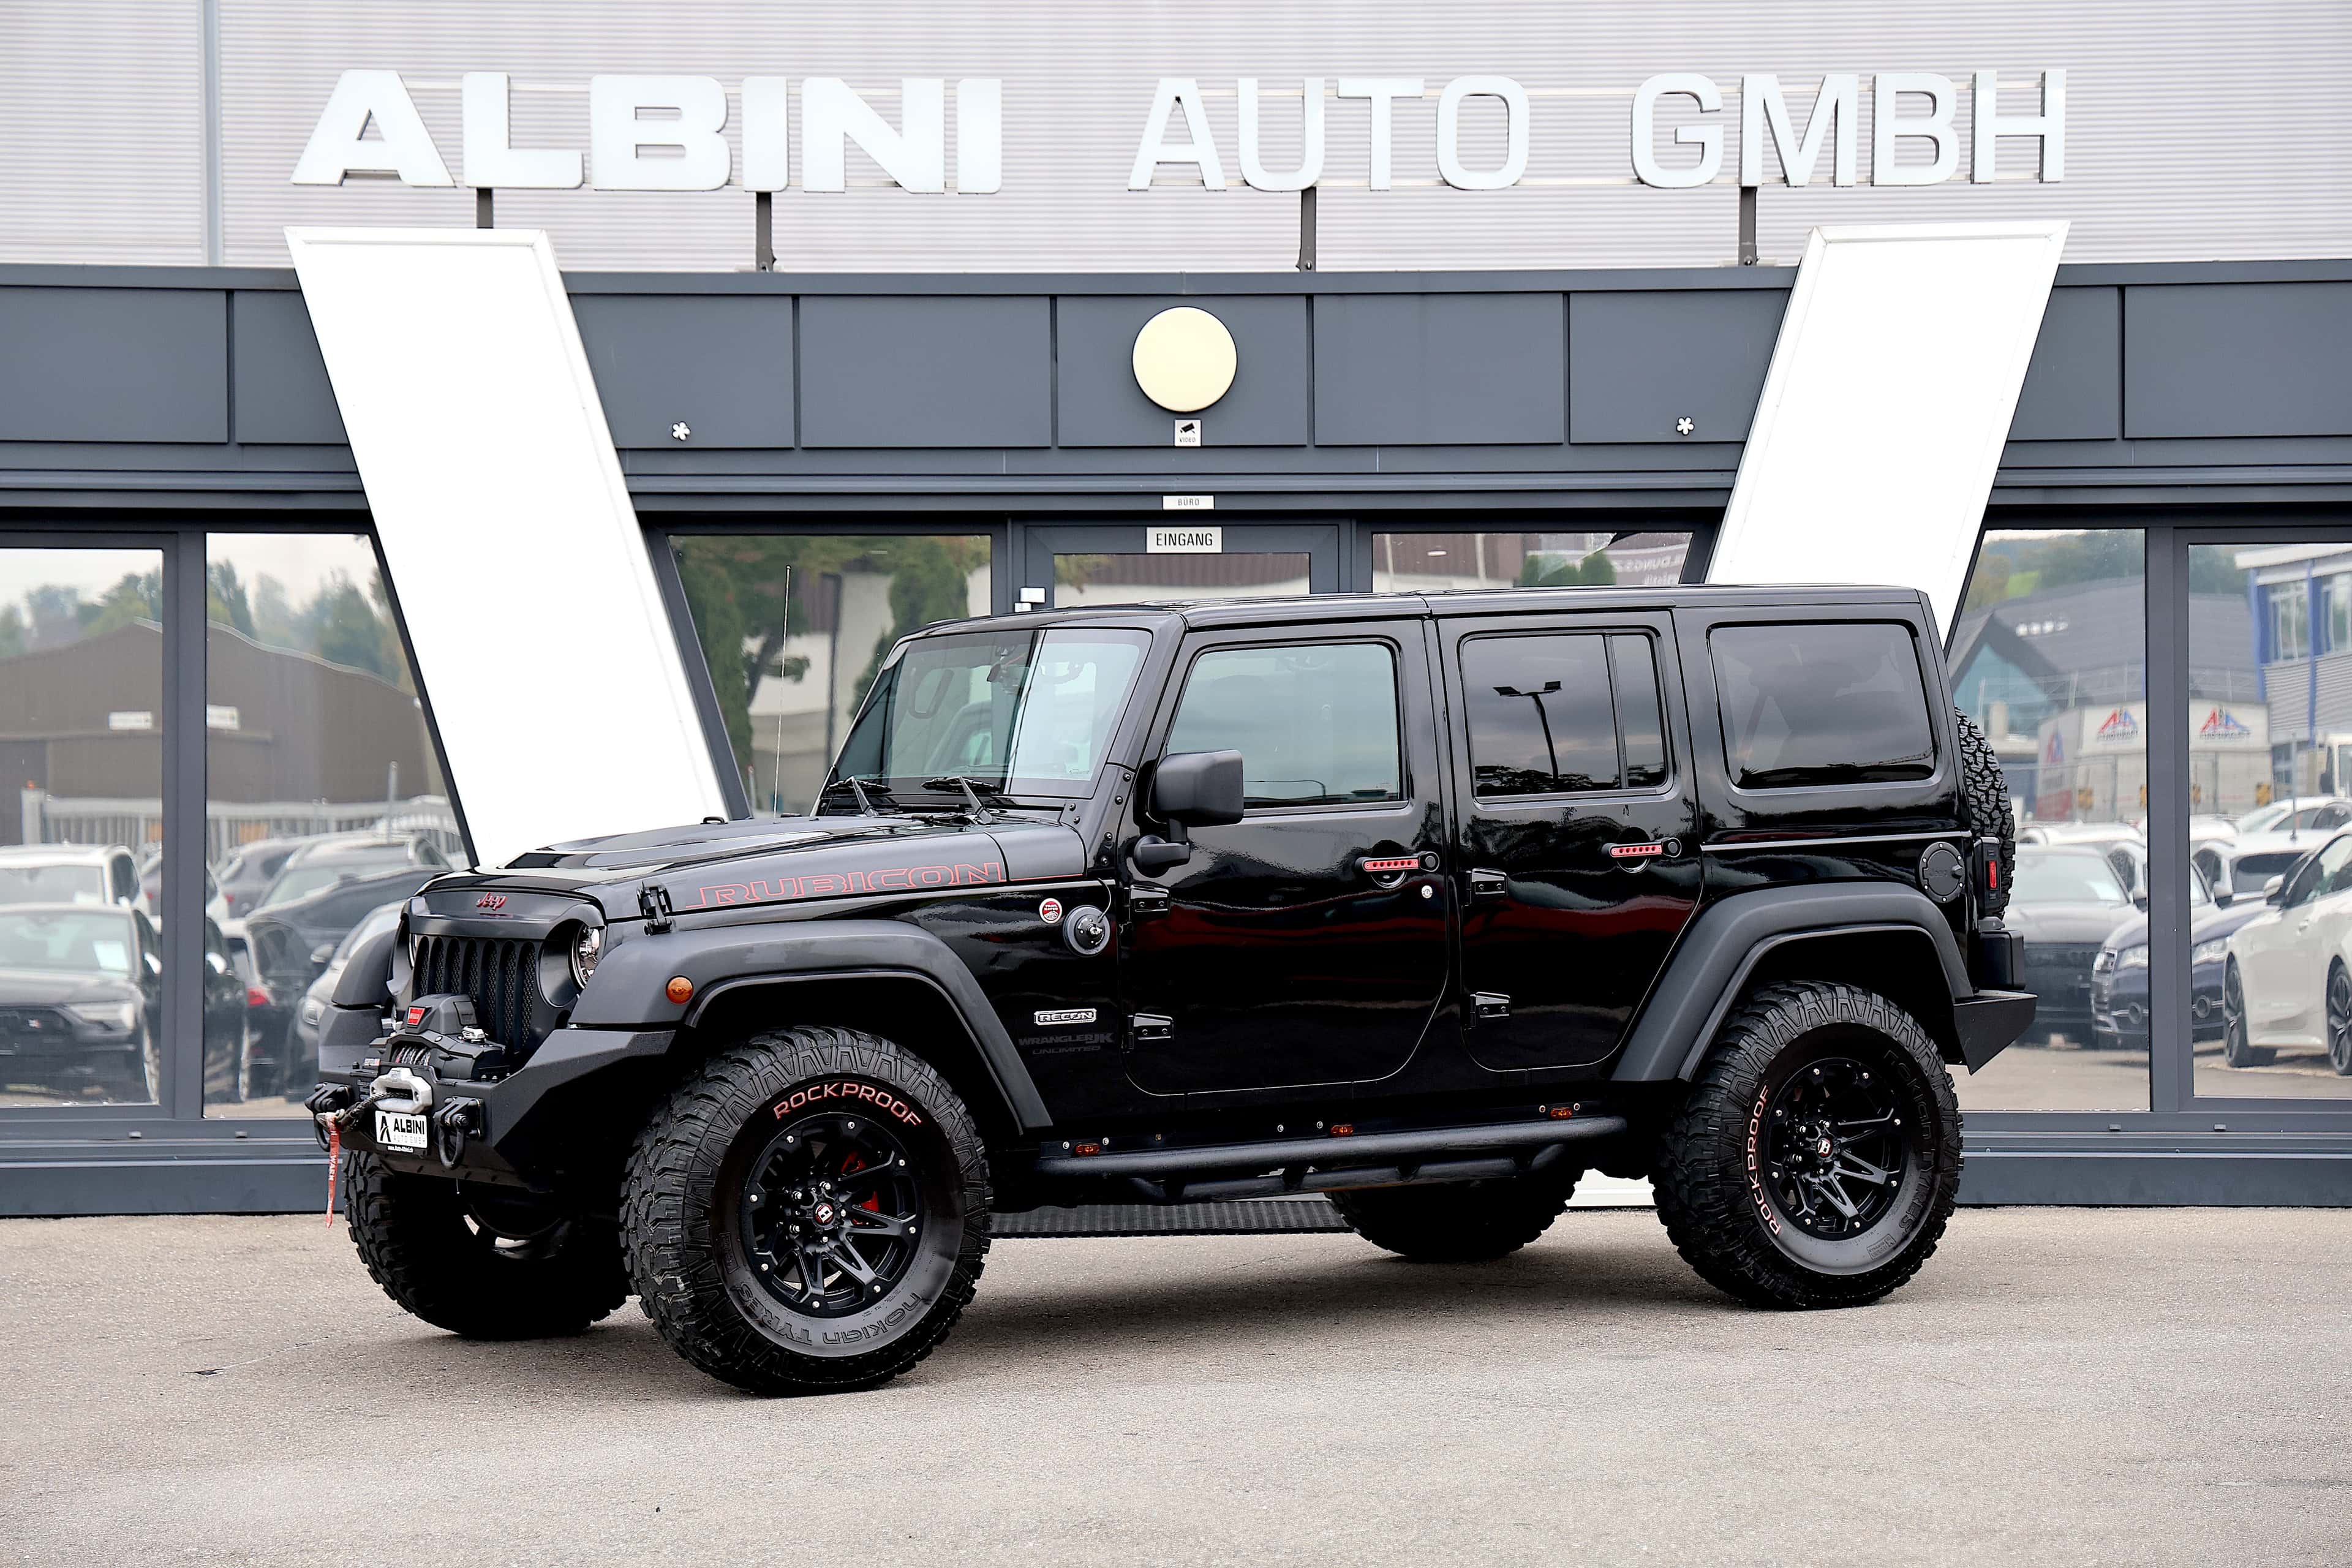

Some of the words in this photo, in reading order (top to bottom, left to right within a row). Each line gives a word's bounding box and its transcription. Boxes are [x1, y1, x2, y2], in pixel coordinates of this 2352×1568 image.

[290, 69, 1002, 195] ALBINI
[1128, 75, 1530, 192] AUTO
[1629, 69, 2068, 189] GMBH
[1177, 497, 1200, 506] BÜRO
[1156, 532, 1213, 546] EINGANG
[686, 862, 1006, 908] RUBICON
[475, 891, 508, 911] Jeep
[1039, 1012, 1093, 1022] RECON
[1032, 1045, 1101, 1055] UNLIMITED
[773, 1082, 922, 1126] ROCKPROOF
[393, 1118, 425, 1134] ALBINI
[328, 1155, 337, 1181] WARN
[1747, 1084, 1781, 1236] ROCKPROOF
[736, 1282, 813, 1346] TYRES
